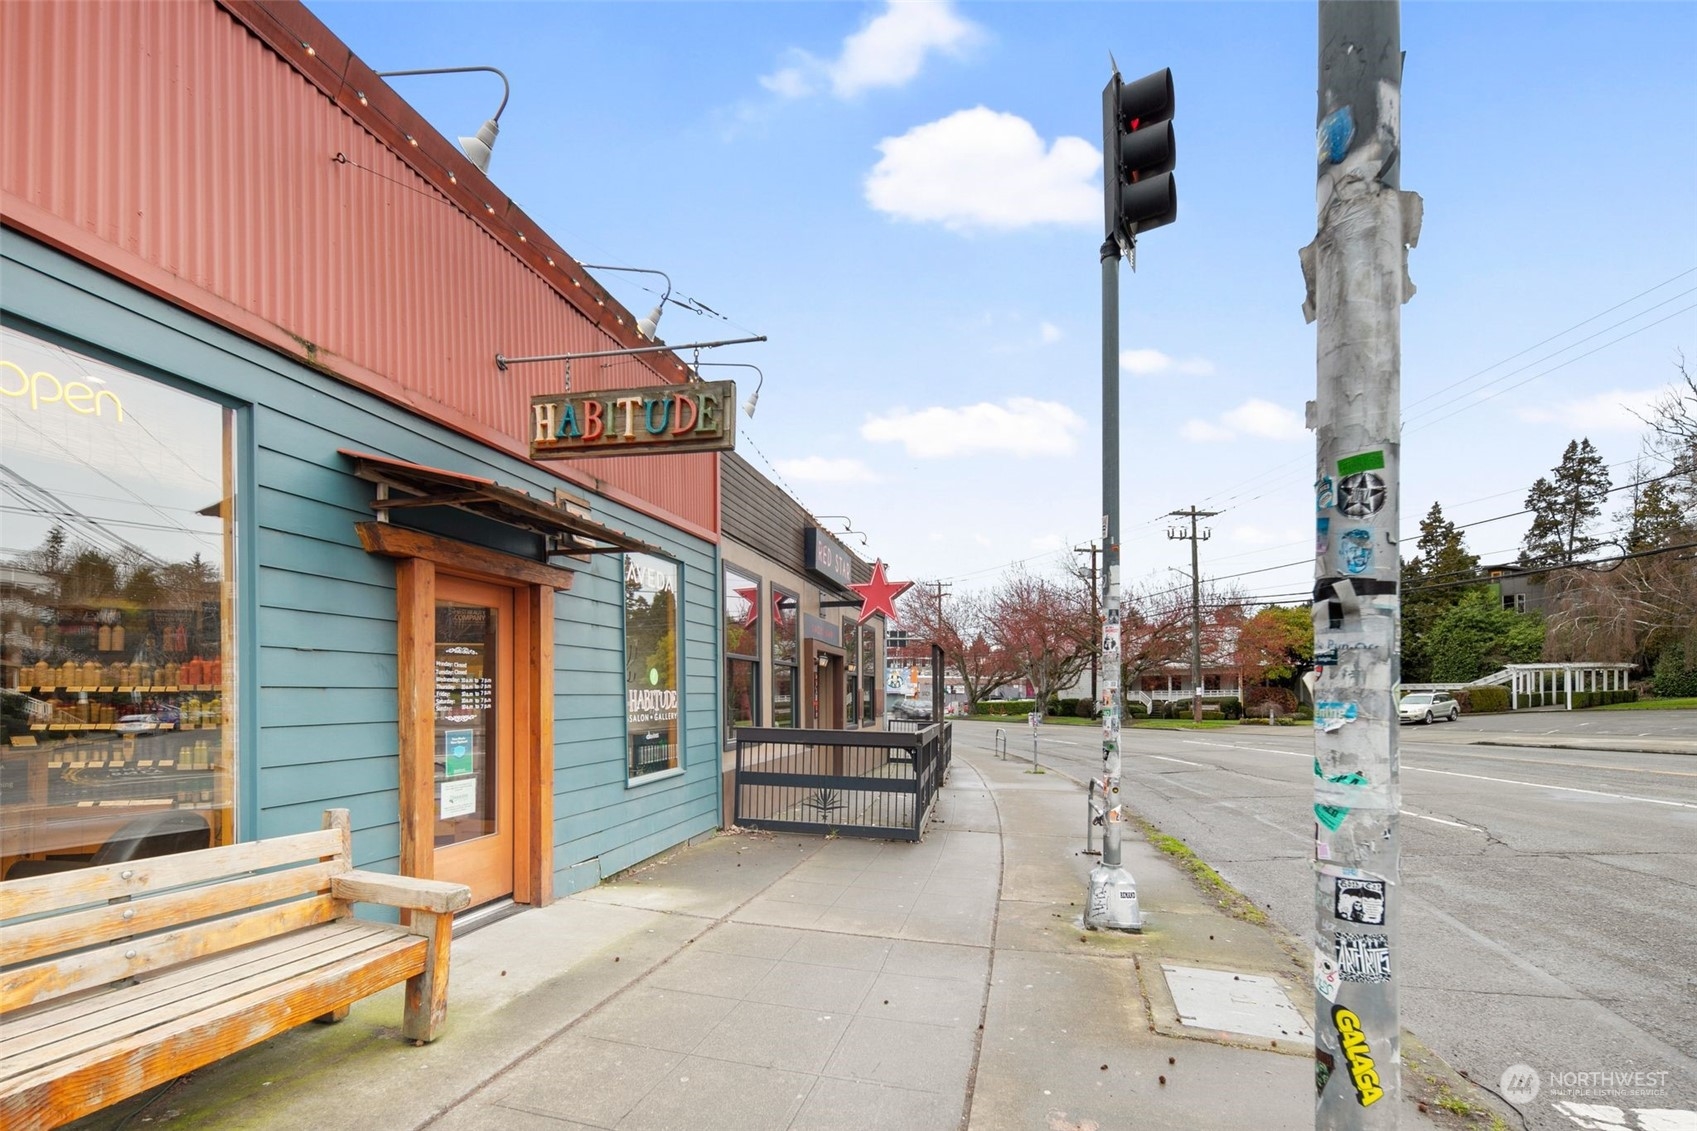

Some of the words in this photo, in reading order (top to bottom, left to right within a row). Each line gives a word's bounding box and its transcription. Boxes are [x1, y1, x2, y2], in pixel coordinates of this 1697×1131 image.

[533, 393, 718, 444] HABITUDE
[626, 560, 674, 594] AVEDA
[818, 540, 832, 568] RED
[835, 554, 850, 581] STAR
[629, 689, 678, 713] HABITUDE
[629, 714, 649, 723] SALON
[653, 712, 677, 721] GALLERY
[1333, 1006, 1384, 1107] GALAGA
